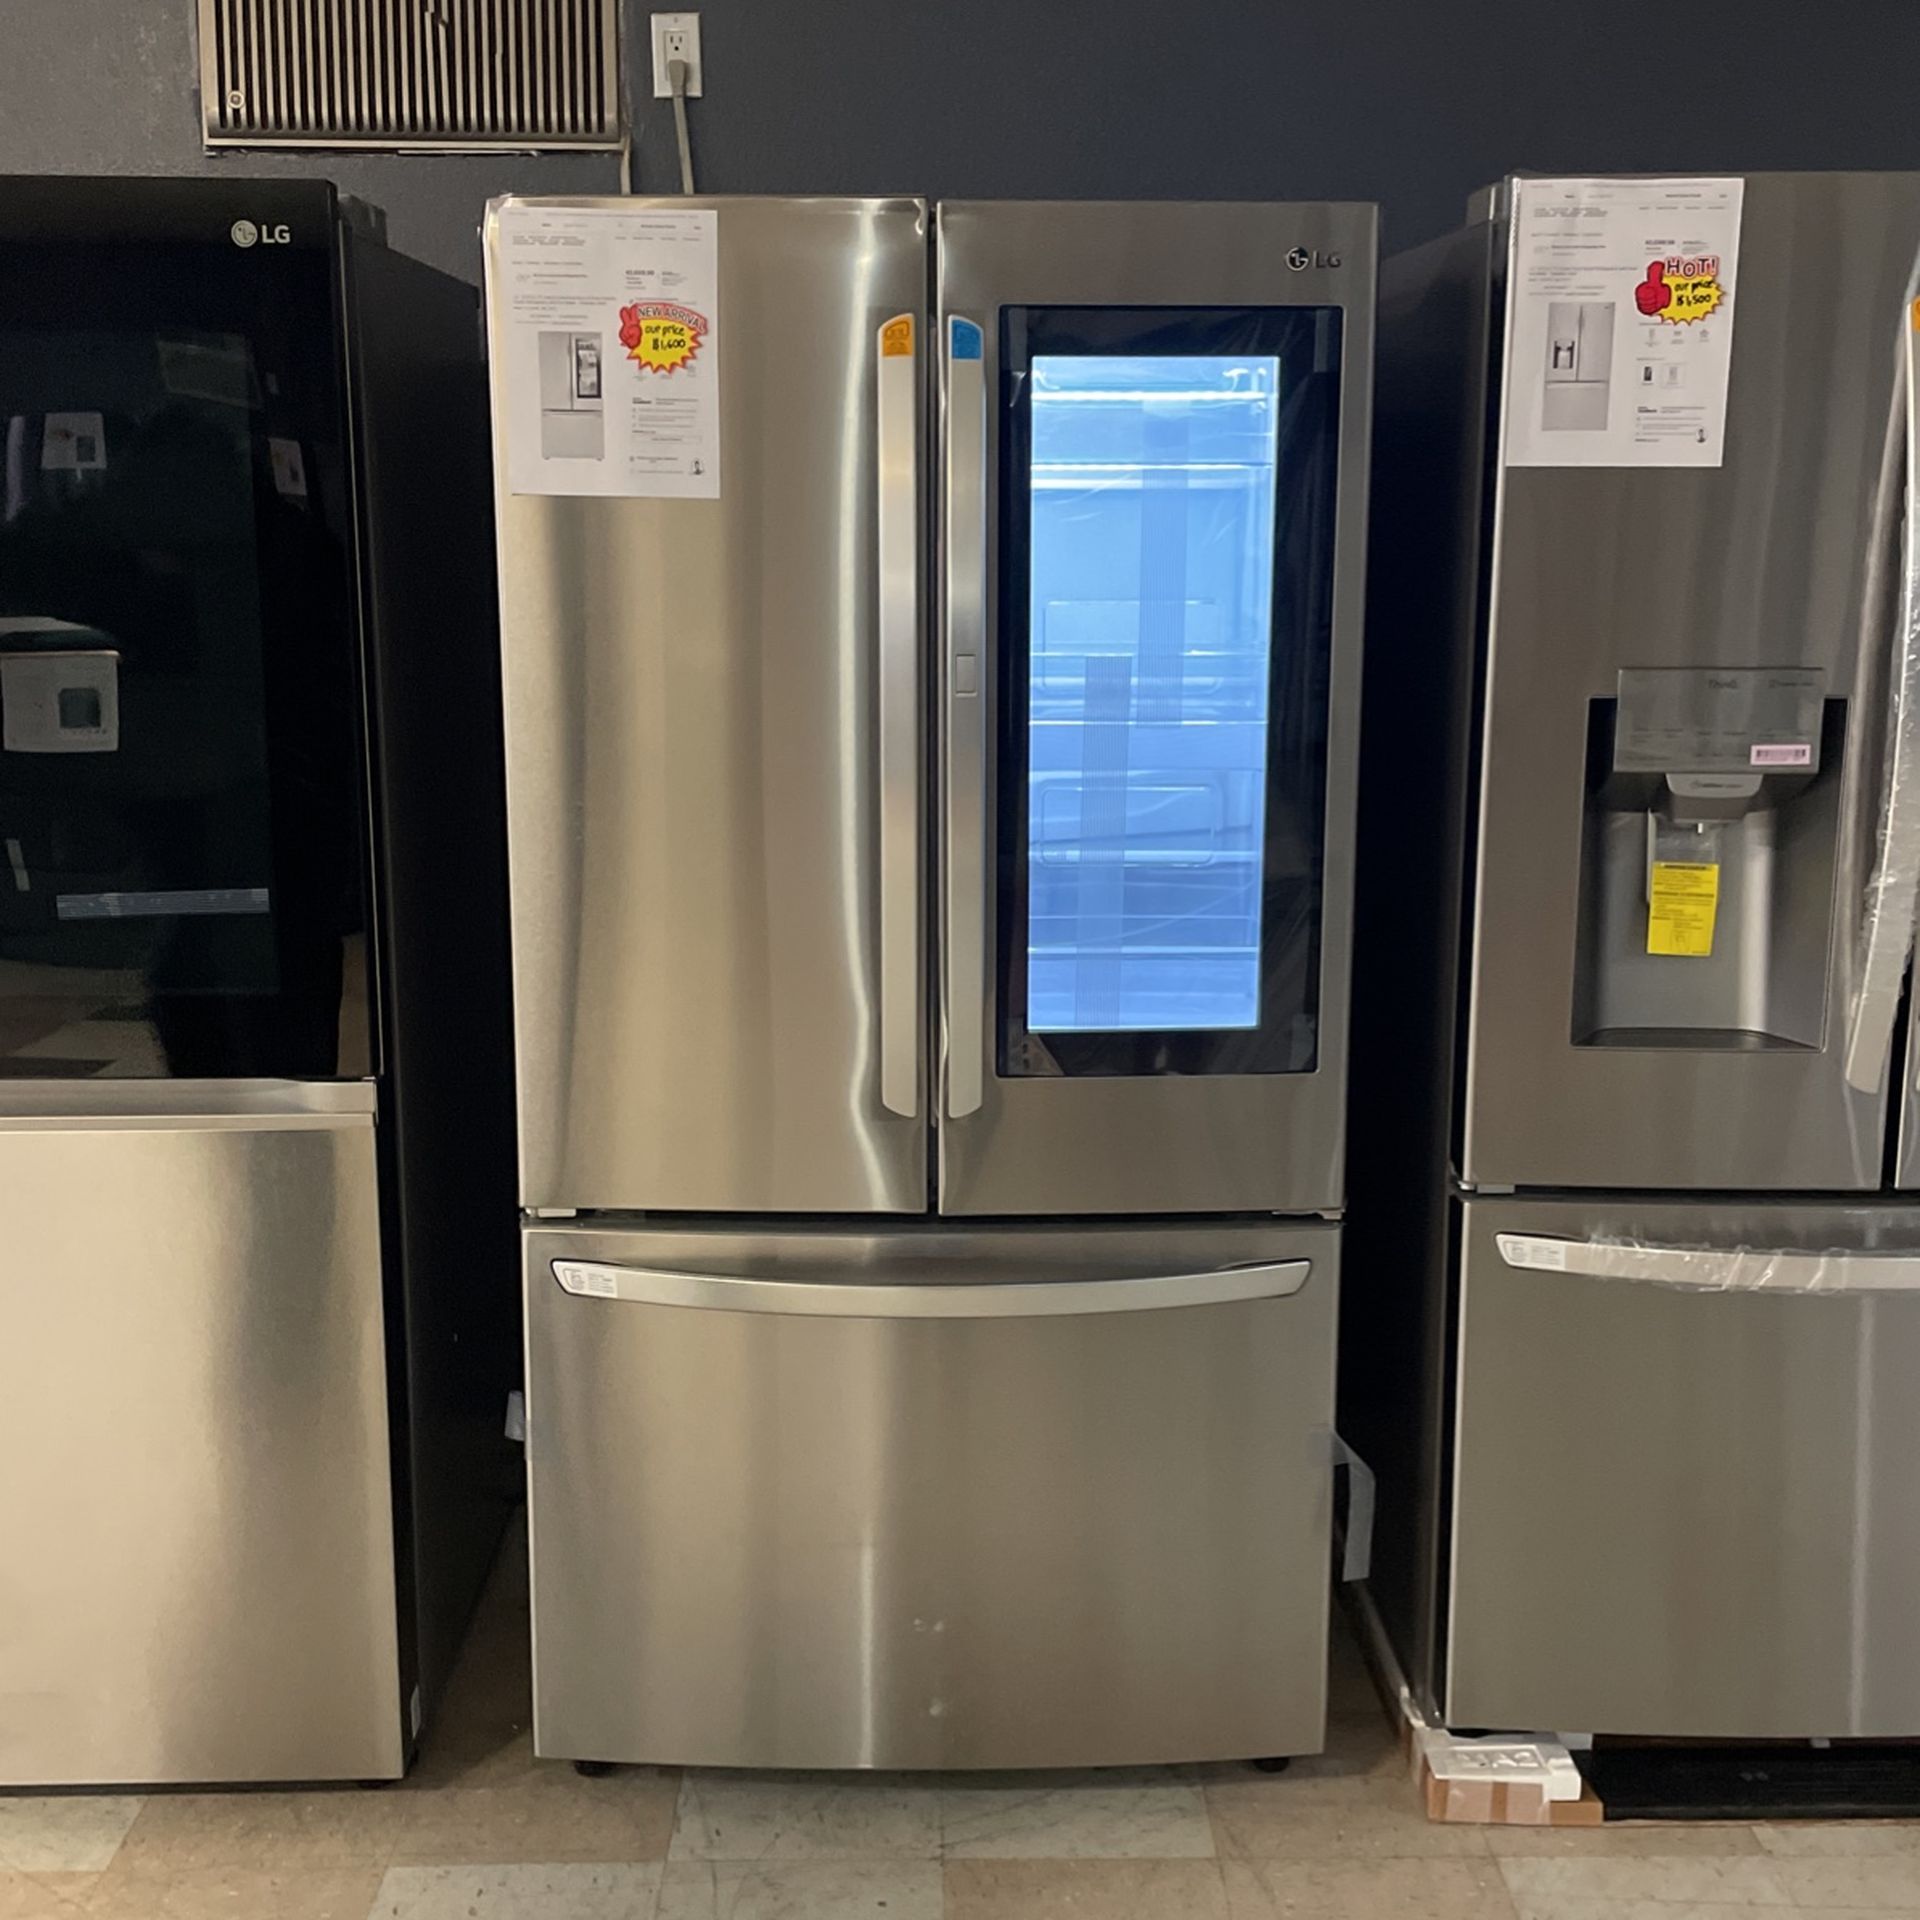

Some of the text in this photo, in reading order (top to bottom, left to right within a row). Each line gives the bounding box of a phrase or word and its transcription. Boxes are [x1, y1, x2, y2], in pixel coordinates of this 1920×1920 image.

[261, 225, 291, 243] LG
[1313, 250, 1341, 269] LG
[1667, 258, 1716, 278] HOT!
[638, 306, 706, 335] NEW ARRIVAL
